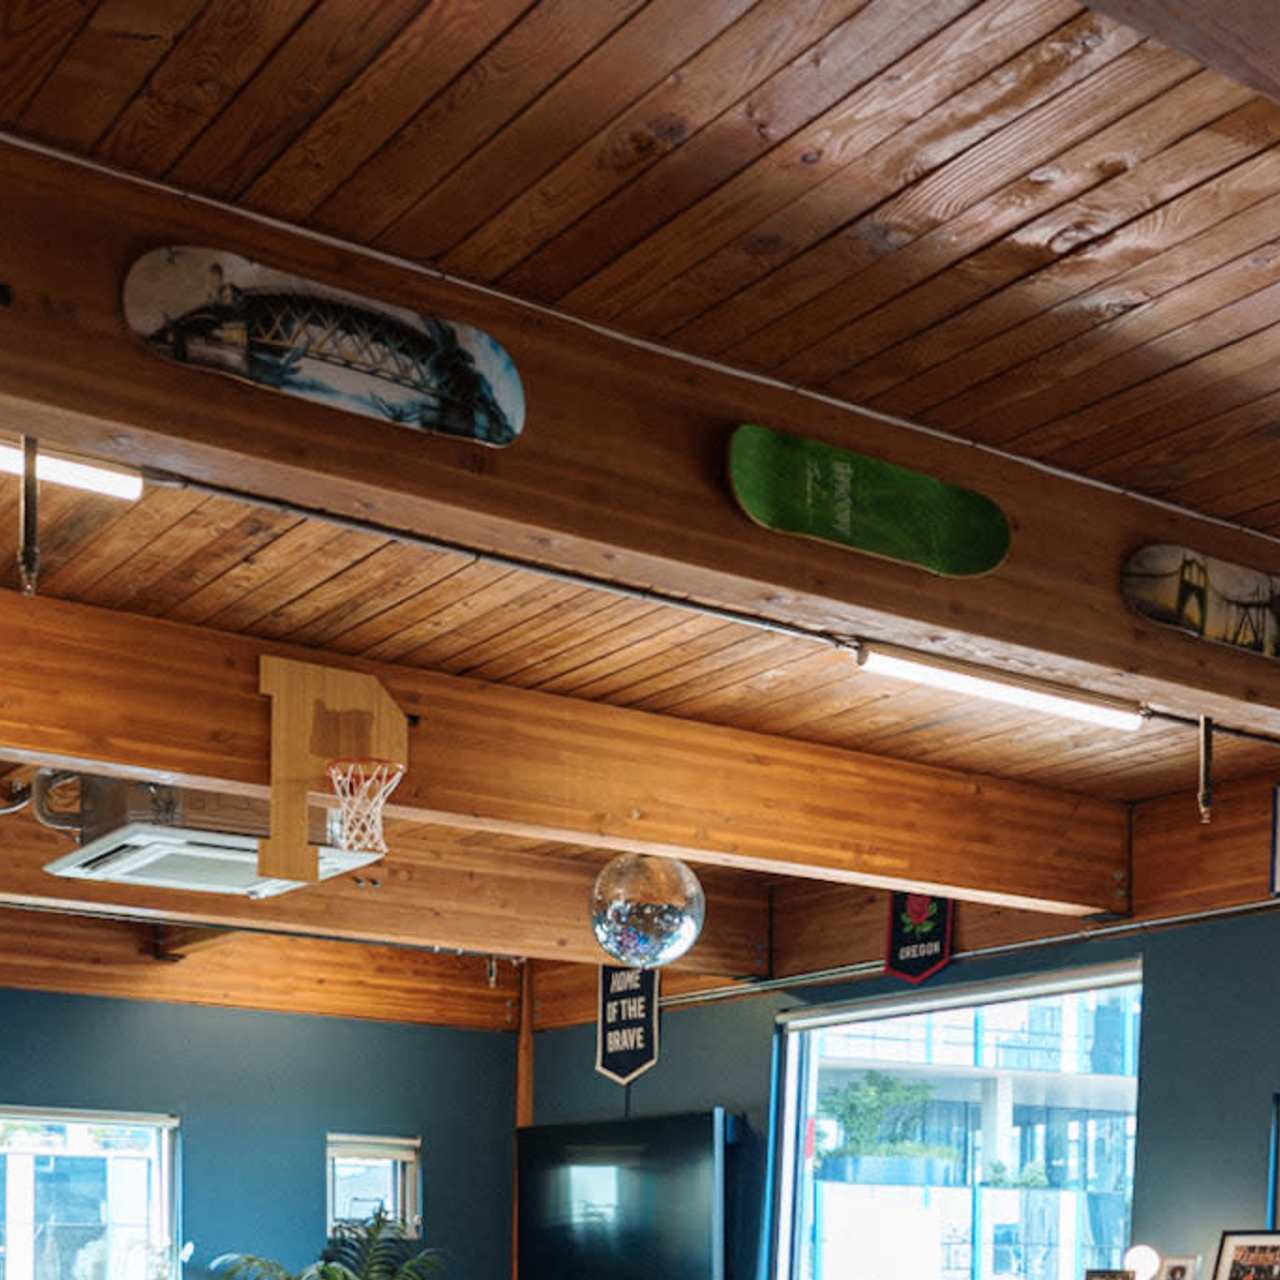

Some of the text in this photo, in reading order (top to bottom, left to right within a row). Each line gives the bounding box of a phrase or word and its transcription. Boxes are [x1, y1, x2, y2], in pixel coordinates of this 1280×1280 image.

[899, 941, 940, 960] OREGON
[610, 970, 641, 993] HOME
[607, 996, 647, 1023] OF THE
[607, 1027, 645, 1053] BRAVE
